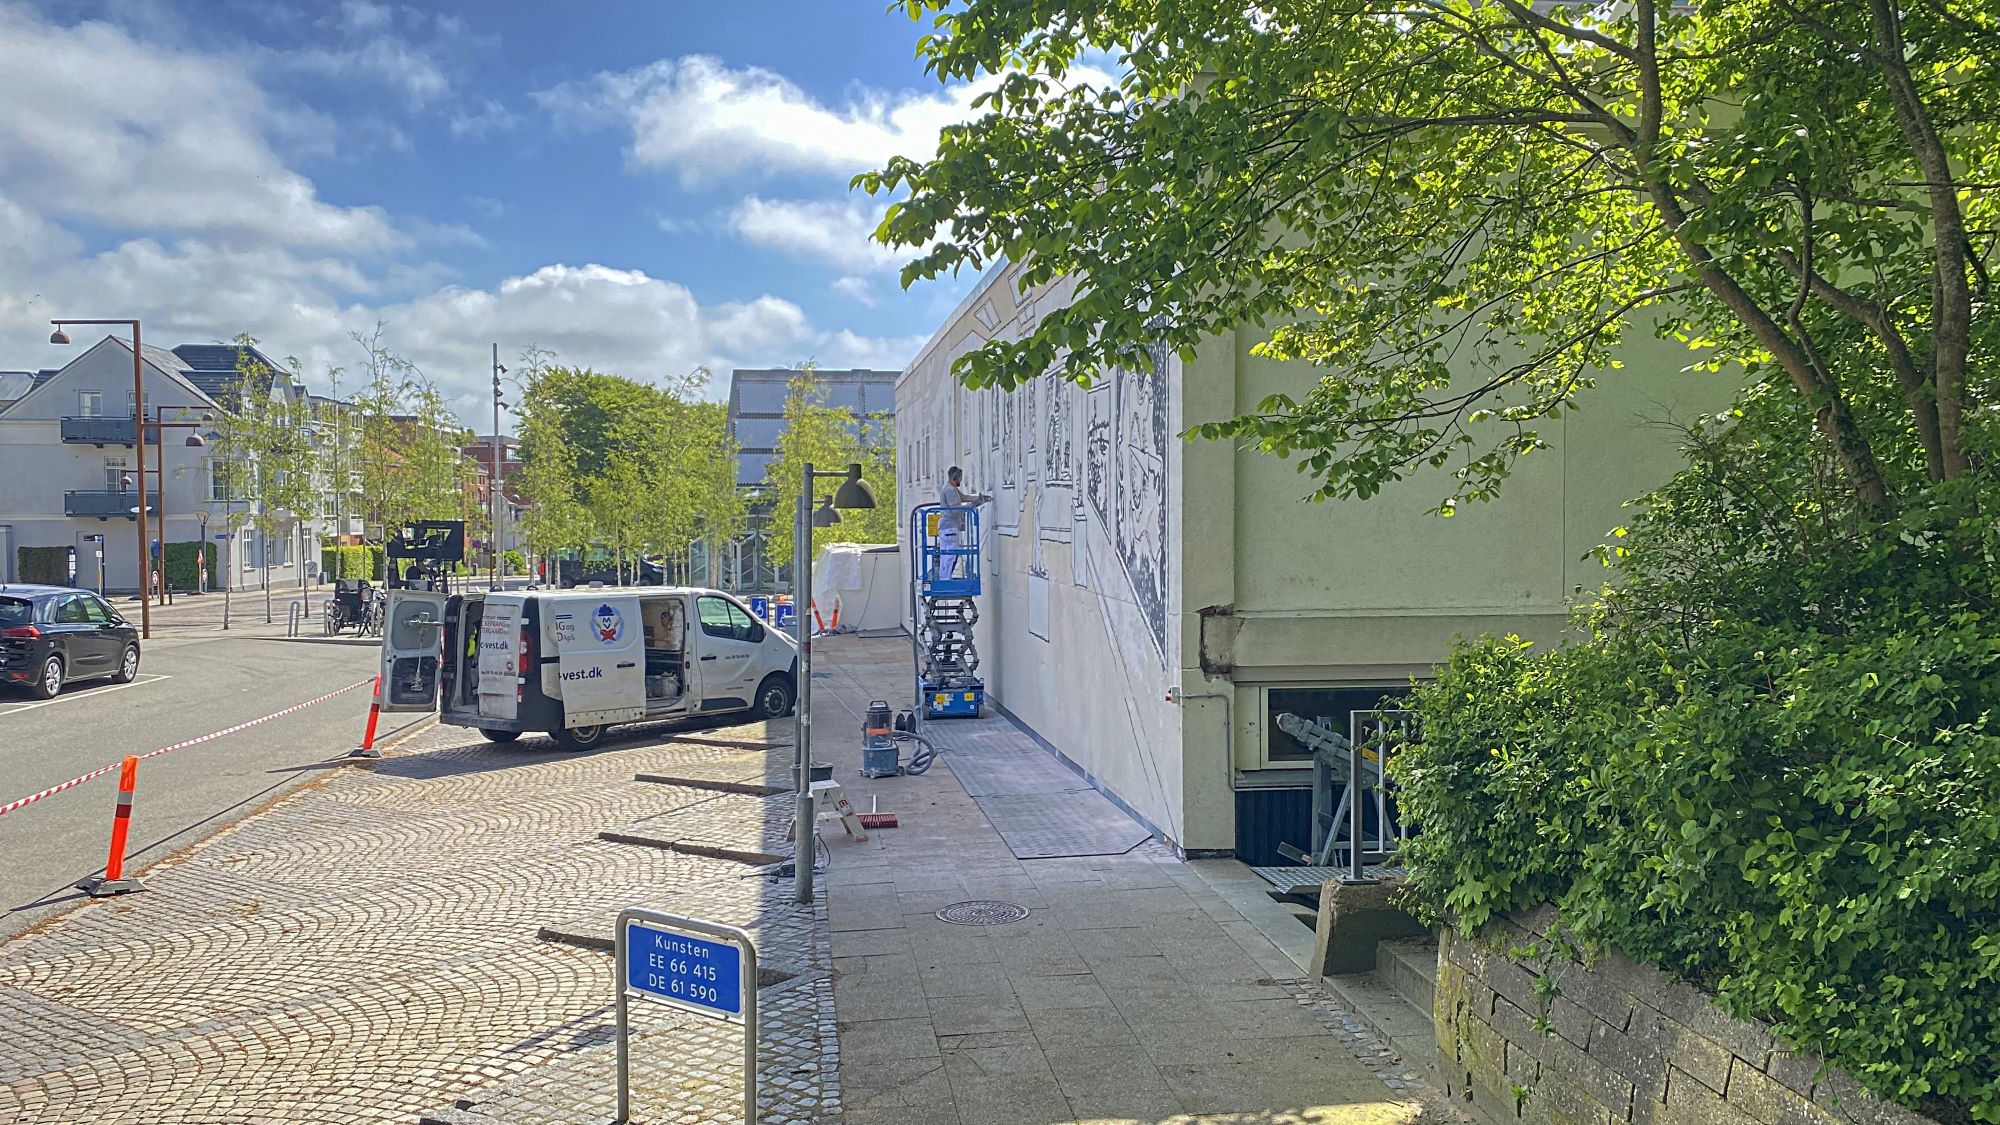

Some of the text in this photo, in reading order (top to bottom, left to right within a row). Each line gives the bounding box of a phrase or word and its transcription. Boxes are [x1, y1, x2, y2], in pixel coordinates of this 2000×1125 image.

[655, 934, 709, 959] Kunsten
[649, 953, 717, 981] EE 66 415
[649, 973, 717, 1003] DE 61 590
